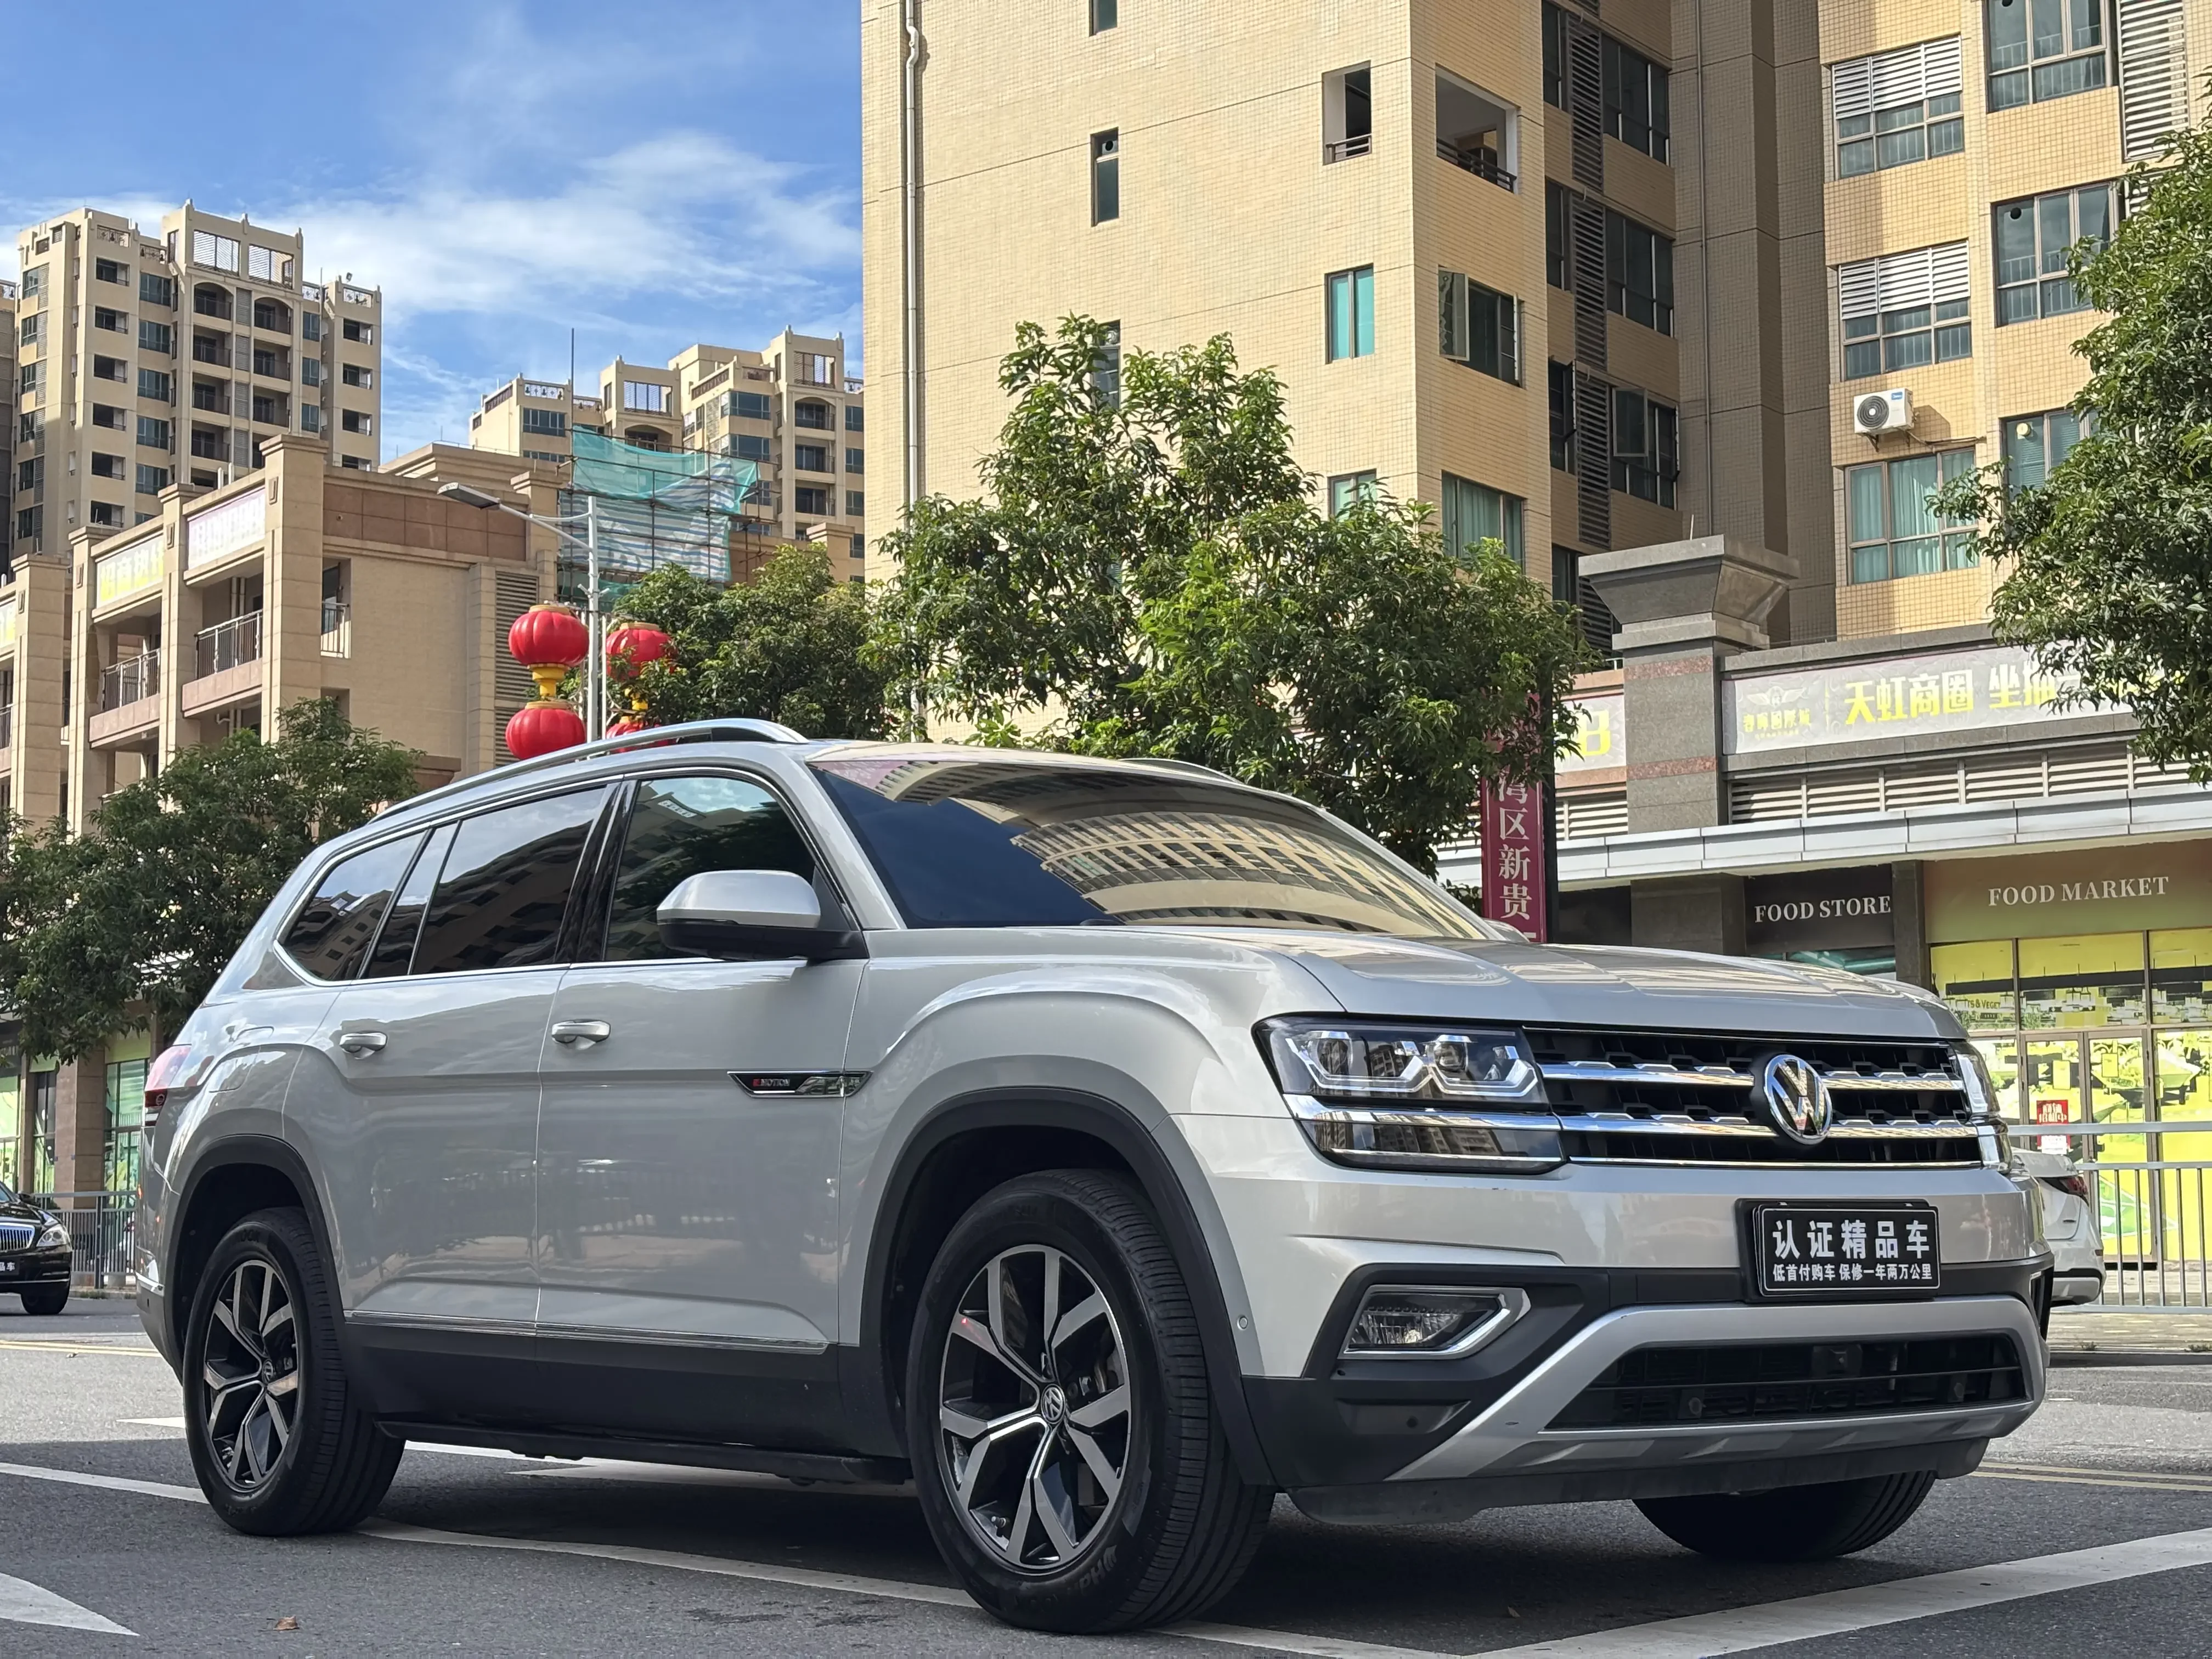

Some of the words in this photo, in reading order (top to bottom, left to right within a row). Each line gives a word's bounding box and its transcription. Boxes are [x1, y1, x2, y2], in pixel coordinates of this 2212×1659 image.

[1844, 669, 1973, 724] 天虹商圈
[1988, 884, 2055, 906] FOOD
[2061, 877, 2169, 901] MARKET
[1754, 902, 1814, 923] FOOD
[1819, 896, 1891, 918] STORE
[1773, 1220, 1929, 1260] 认证精品车
[1773, 1263, 1836, 1282] 低首付购车
[1839, 1263, 1933, 1281] 保修一年两万公里
